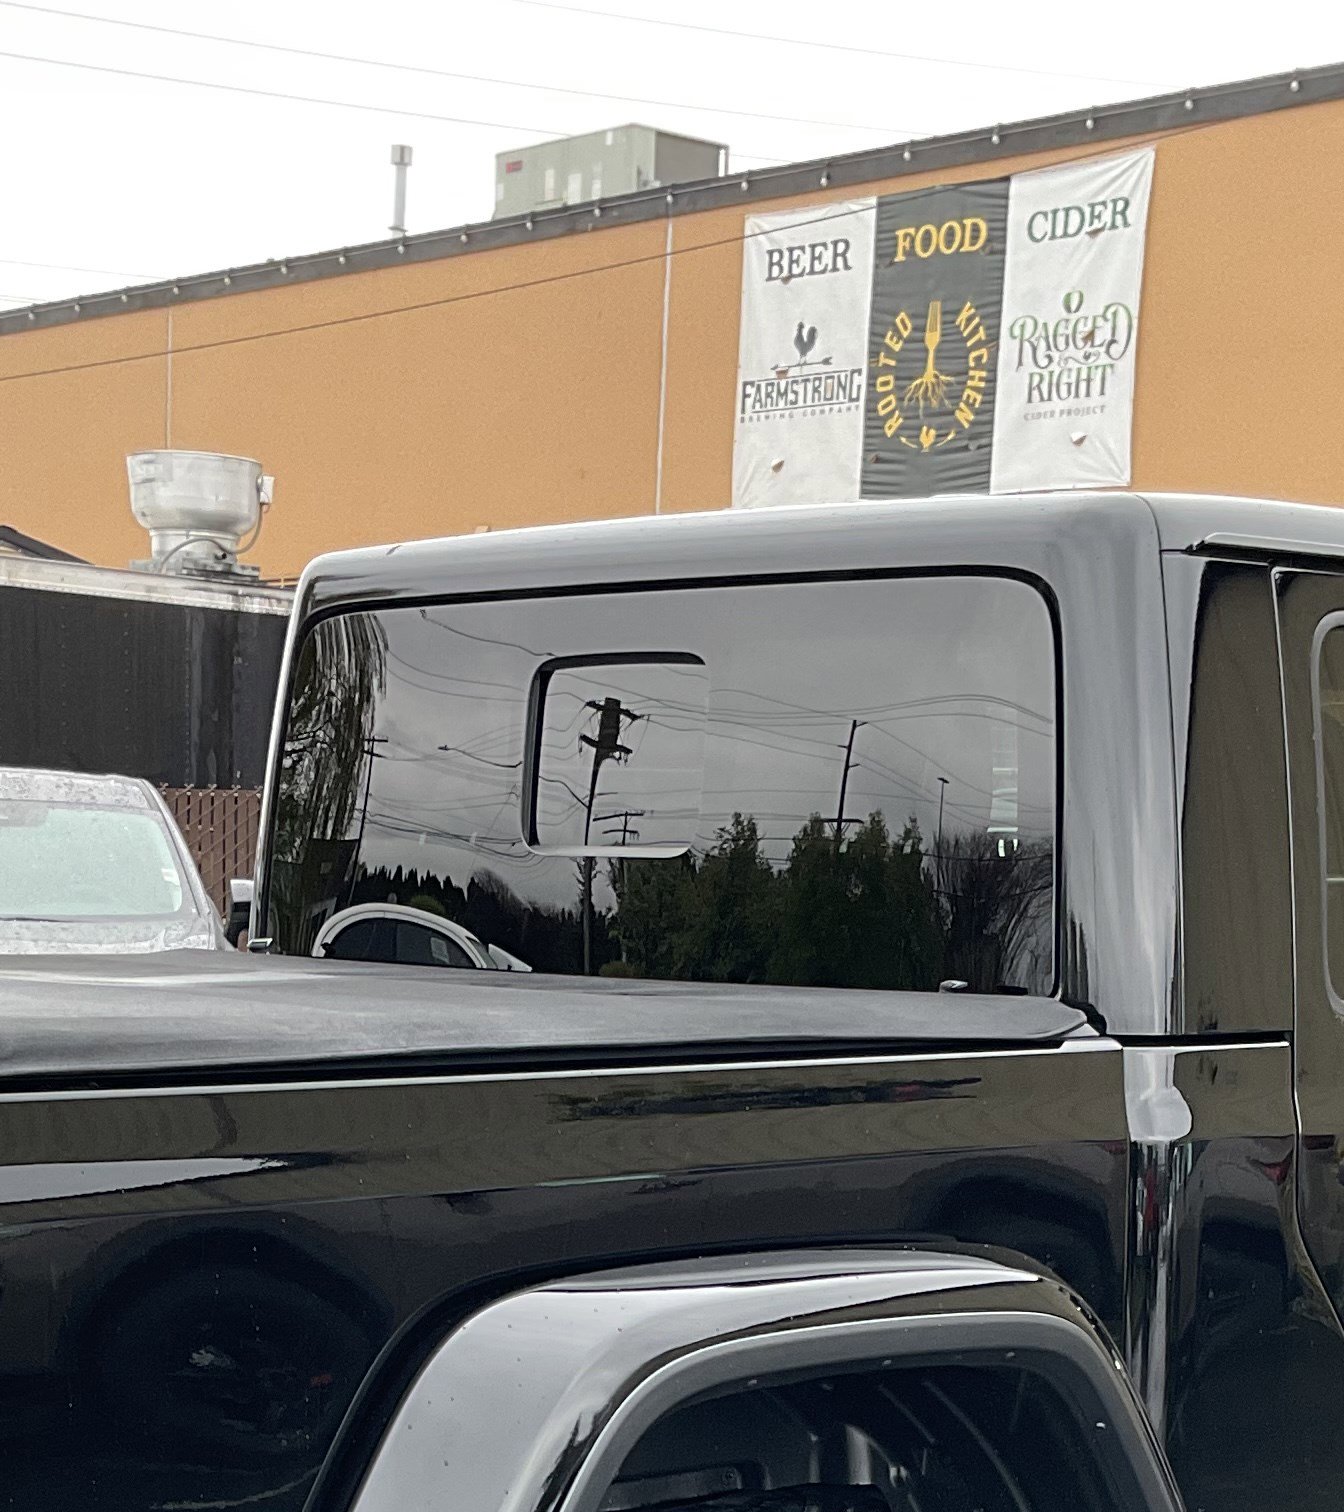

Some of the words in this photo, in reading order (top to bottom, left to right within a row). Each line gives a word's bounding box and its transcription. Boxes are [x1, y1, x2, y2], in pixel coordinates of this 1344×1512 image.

[894, 217, 988, 263] FOOD
[1027, 196, 1132, 243] CIDER
[766, 238, 853, 283] BEER
[1009, 302, 1133, 372] RAGGED
[875, 311, 913, 438] ROOTED
[955, 301, 989, 430] KITCHEN
[1027, 363, 1115, 404] RIGHT
[741, 368, 863, 415] FARMSTRONG
[802, 404, 860, 418] COMPANY
[1023, 409, 1056, 421] CIDER
[1059, 404, 1106, 417] PROJECT
